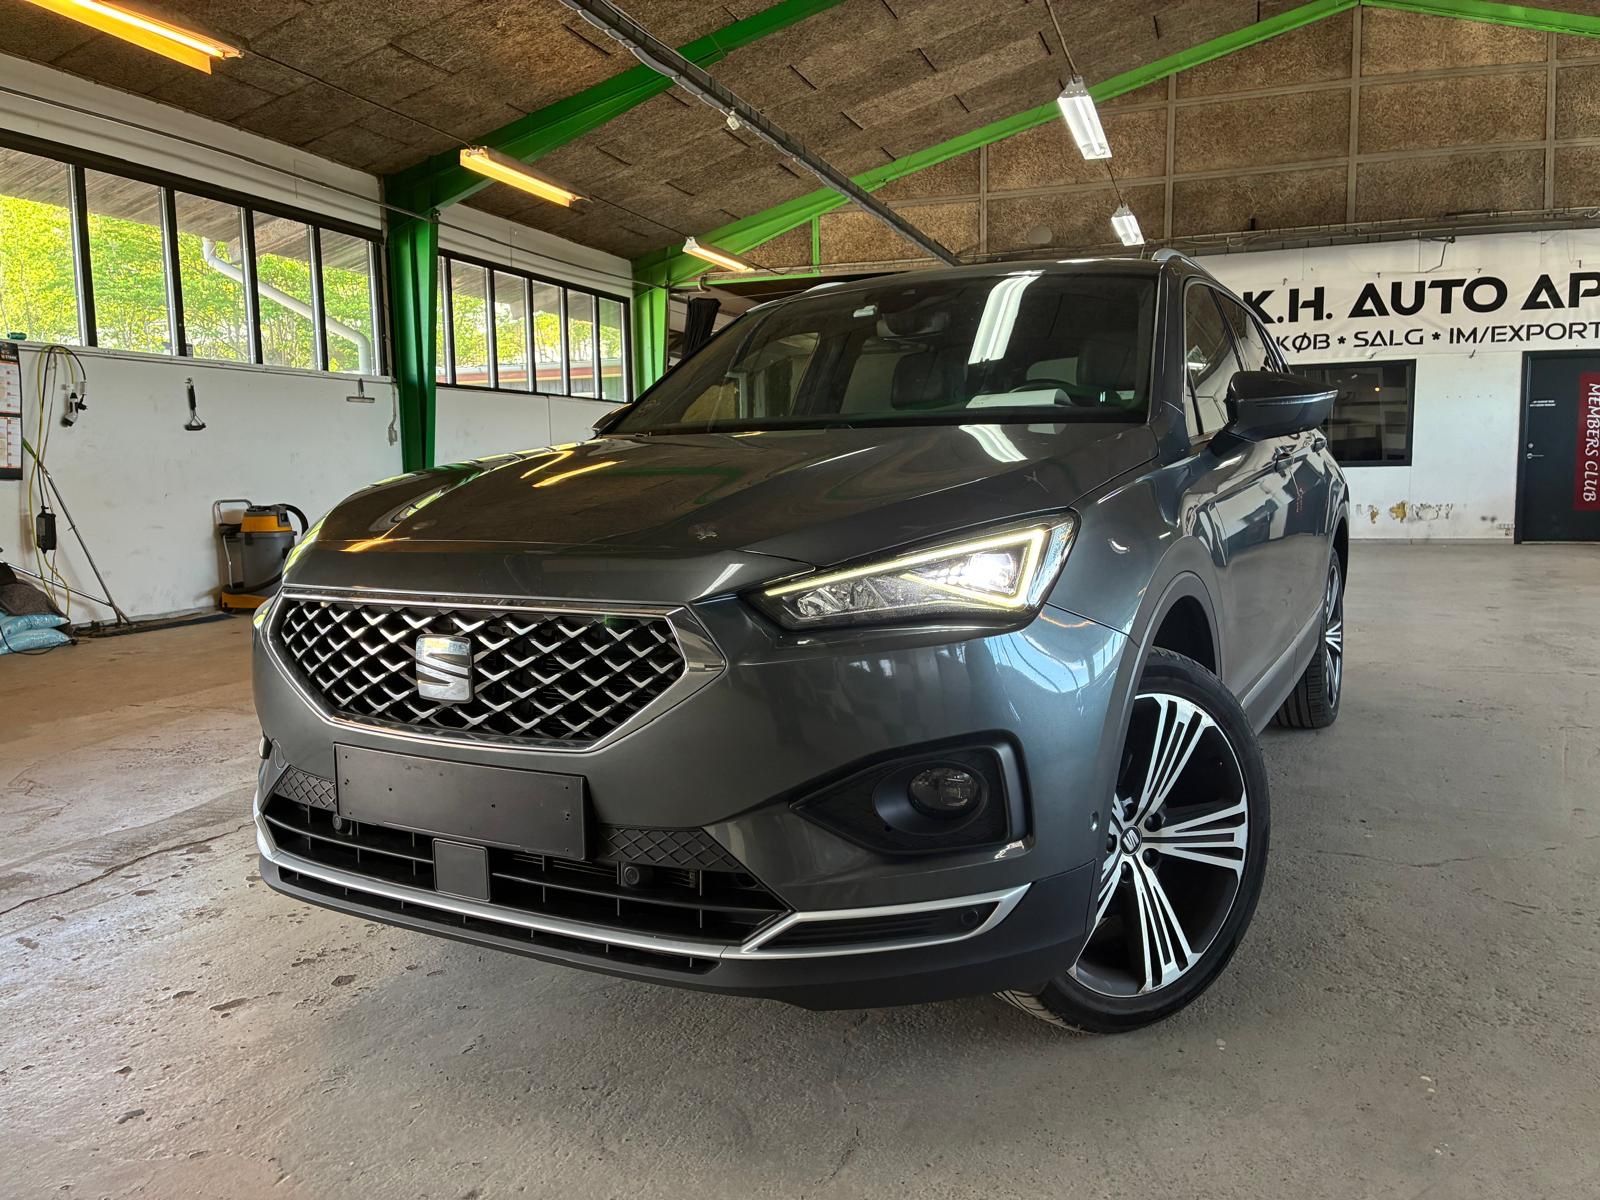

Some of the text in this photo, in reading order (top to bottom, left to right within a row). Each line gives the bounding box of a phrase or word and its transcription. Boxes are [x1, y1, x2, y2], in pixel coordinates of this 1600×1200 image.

[1243, 286, 1333, 324] K.H.
[1348, 276, 1508, 318] AUTO
[1276, 322, 1600, 353] KØB SALG IM/EXPORT
[1583, 383, 1600, 502] MEMBERS CLUB
